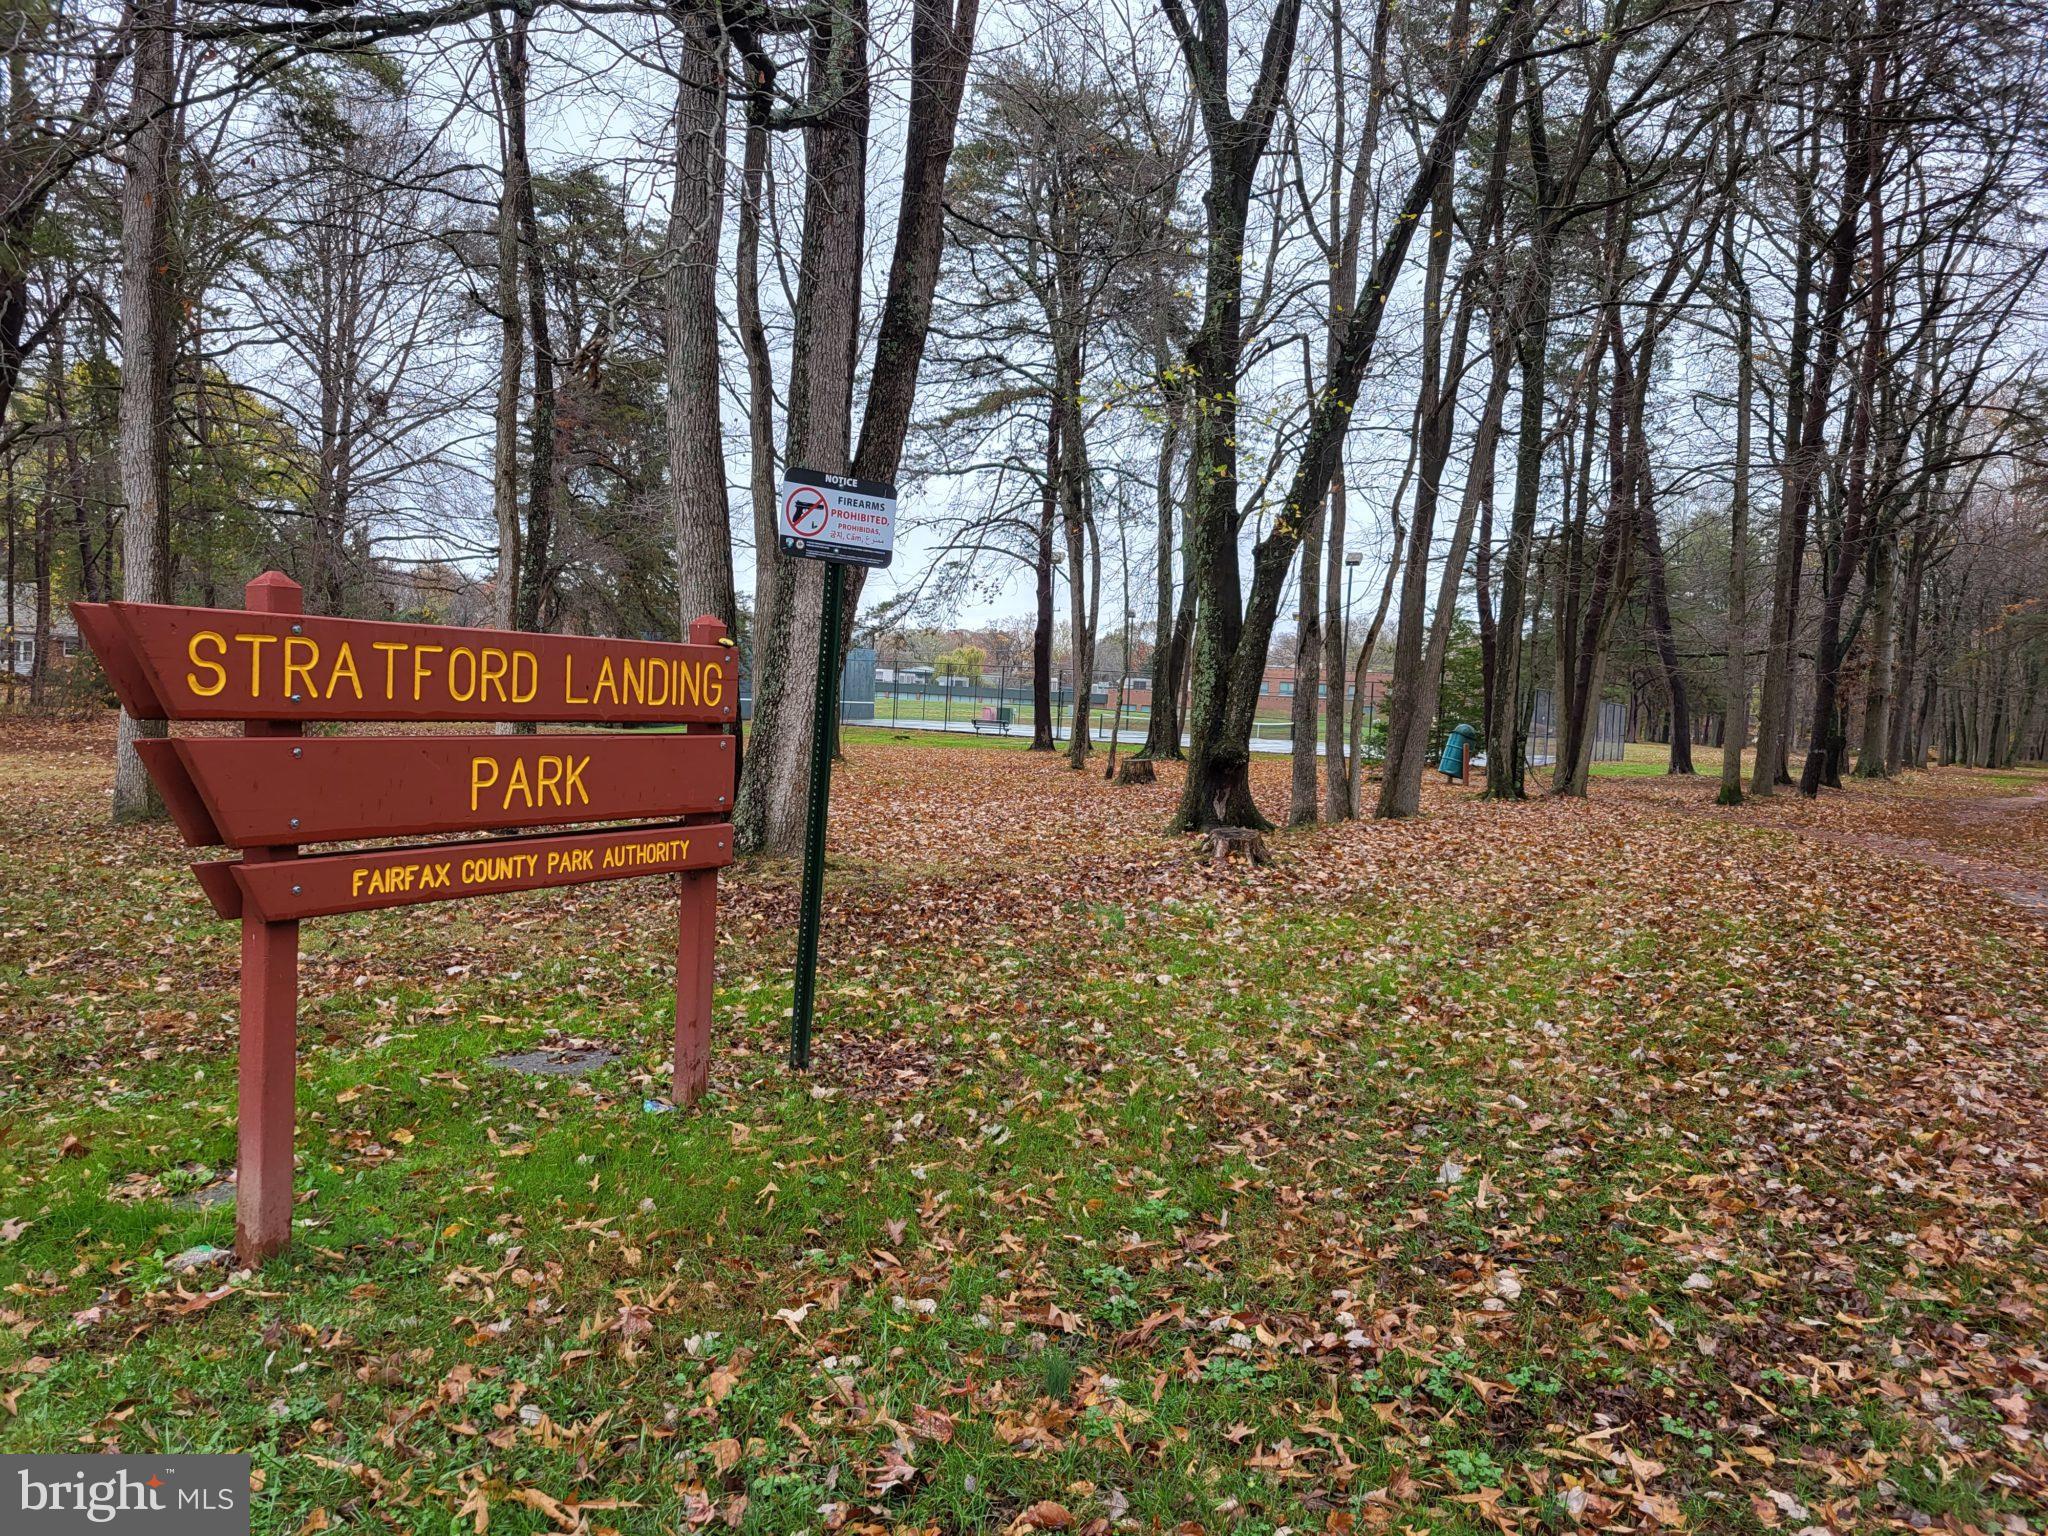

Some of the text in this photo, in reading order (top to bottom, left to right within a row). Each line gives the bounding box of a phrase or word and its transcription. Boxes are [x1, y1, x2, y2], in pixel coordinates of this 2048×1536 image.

[825, 474, 858, 488] NOTICE
[830, 508, 890, 526] PROHIBITED,
[837, 496, 886, 512] FIREARMS
[187, 630, 723, 707] STRATFORD LANDING
[471, 754, 591, 812] PARK
[352, 839, 691, 897] FAIRFAX COUNTY PARK AUTHORITY
